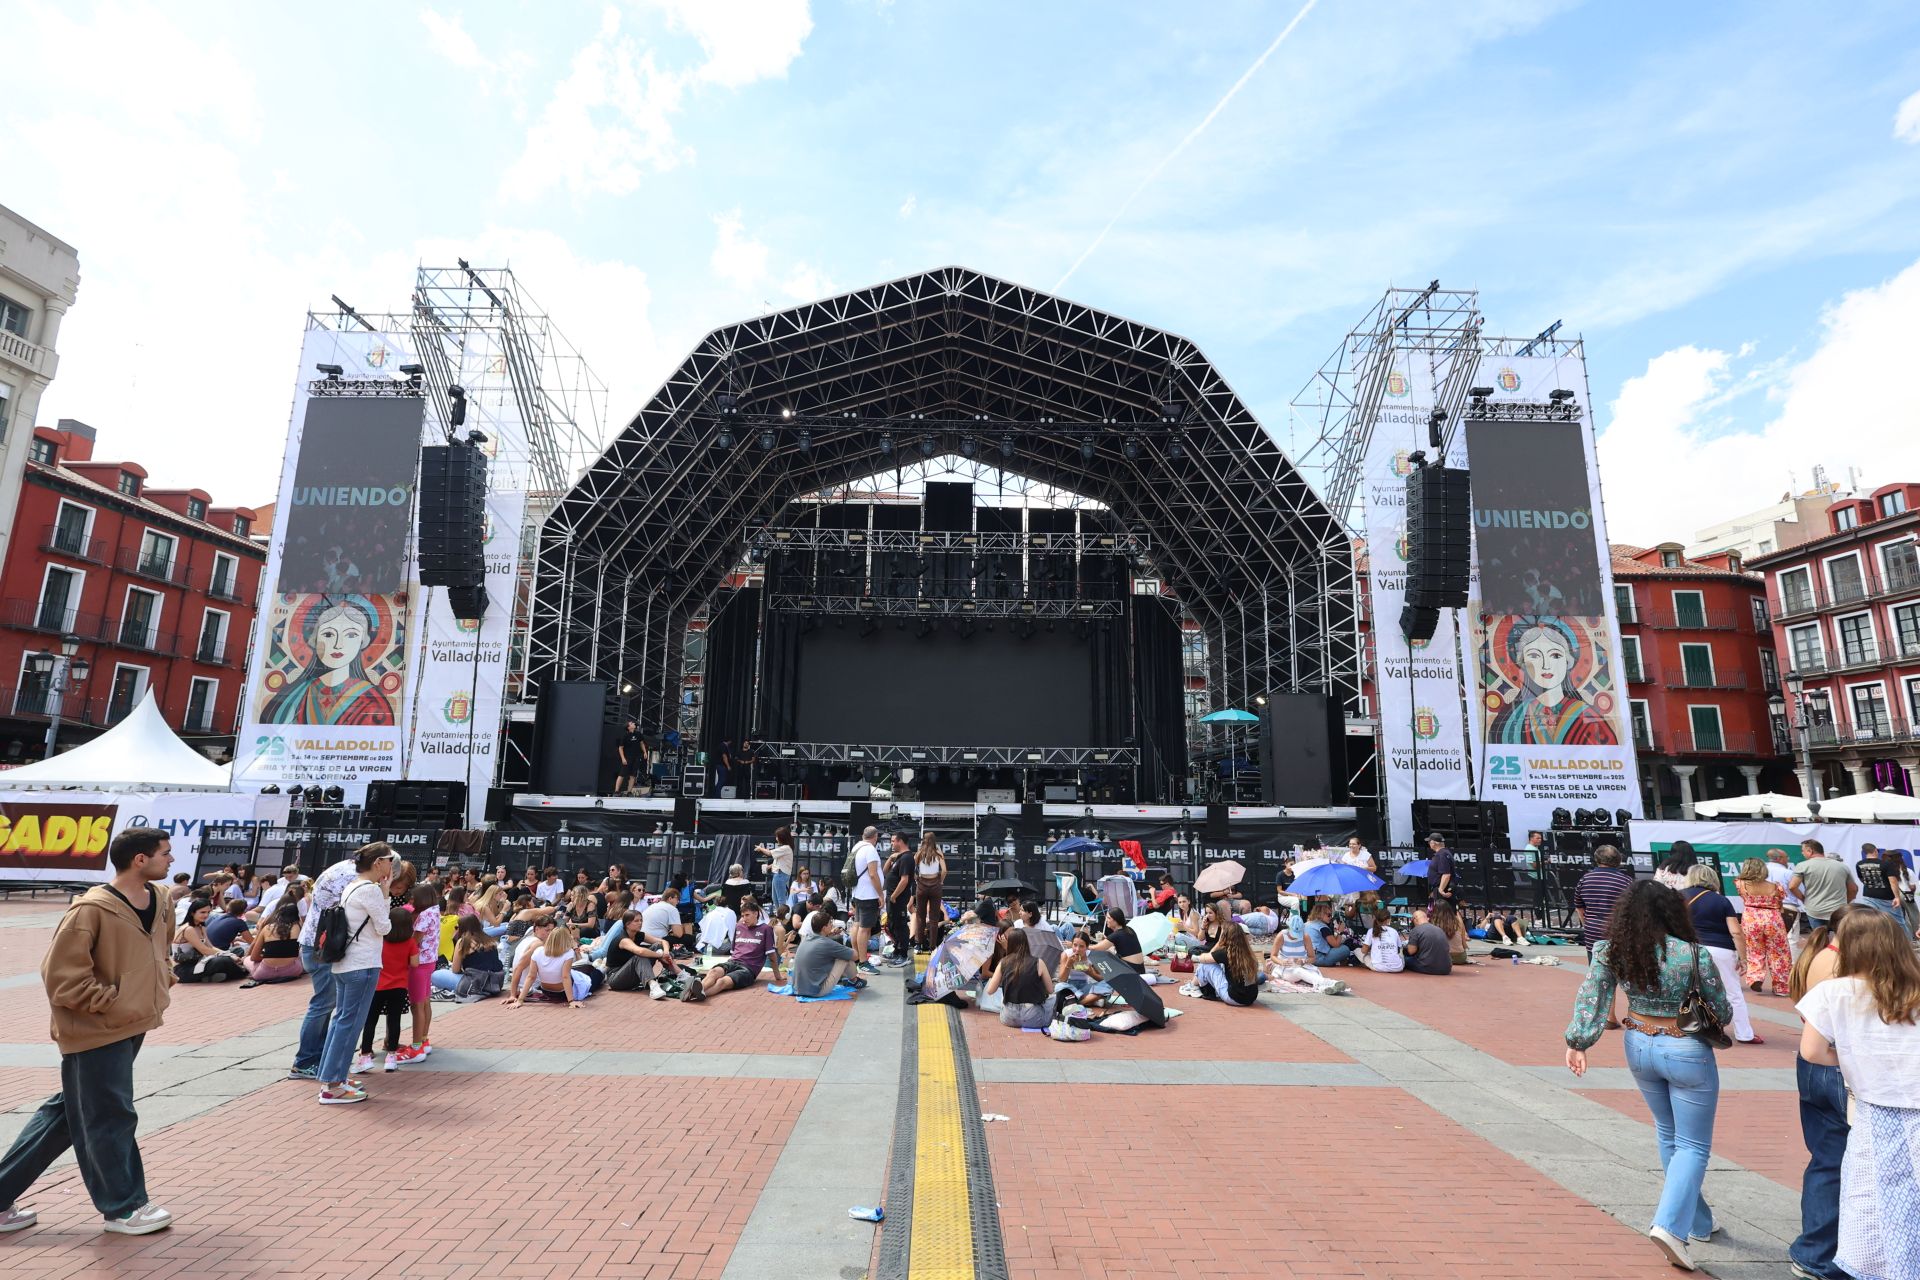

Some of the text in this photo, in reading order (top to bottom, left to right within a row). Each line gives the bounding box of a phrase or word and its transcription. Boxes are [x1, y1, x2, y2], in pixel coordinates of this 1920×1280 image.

[292, 486, 407, 506] UNIENDO
[1474, 509, 1589, 530] UNIENDO
[492, 641, 502, 649] de
[431, 649, 501, 663] Valladolid
[1442, 657, 1451, 665] de
[295, 739, 395, 751] VALLADOLID
[421, 741, 491, 754] Valladolid
[1489, 755, 1522, 775] 25
[1528, 759, 1624, 771] VALLADOLID
[315, 773, 357, 781] LORENZO
[1557, 792, 1598, 800] LORENZO
[209, 830, 248, 841] BLAPE
[266, 831, 311, 842] BLAPE
[328, 832, 371, 843] BLAPE
[387, 834, 428, 844] BLAPE
[501, 836, 544, 846] BLAPE
[560, 836, 603, 847] BLAPE
[620, 837, 663, 848] BLAPE
[681, 839, 715, 849] BLAP
[799, 842, 841, 852] BLAPE
[975, 845, 1016, 856] BLAPE
[1092, 848, 1124, 858] BLAP
[1148, 849, 1189, 860] BLAPE
[1205, 848, 1246, 859] BLAPE
[1263, 849, 1296, 859] BLAP
[1379, 851, 1420, 861] BLAPE
[1453, 853, 1477, 863] APE
[1493, 853, 1535, 864] BLAPE
[1550, 854, 1592, 865] BLAPE
